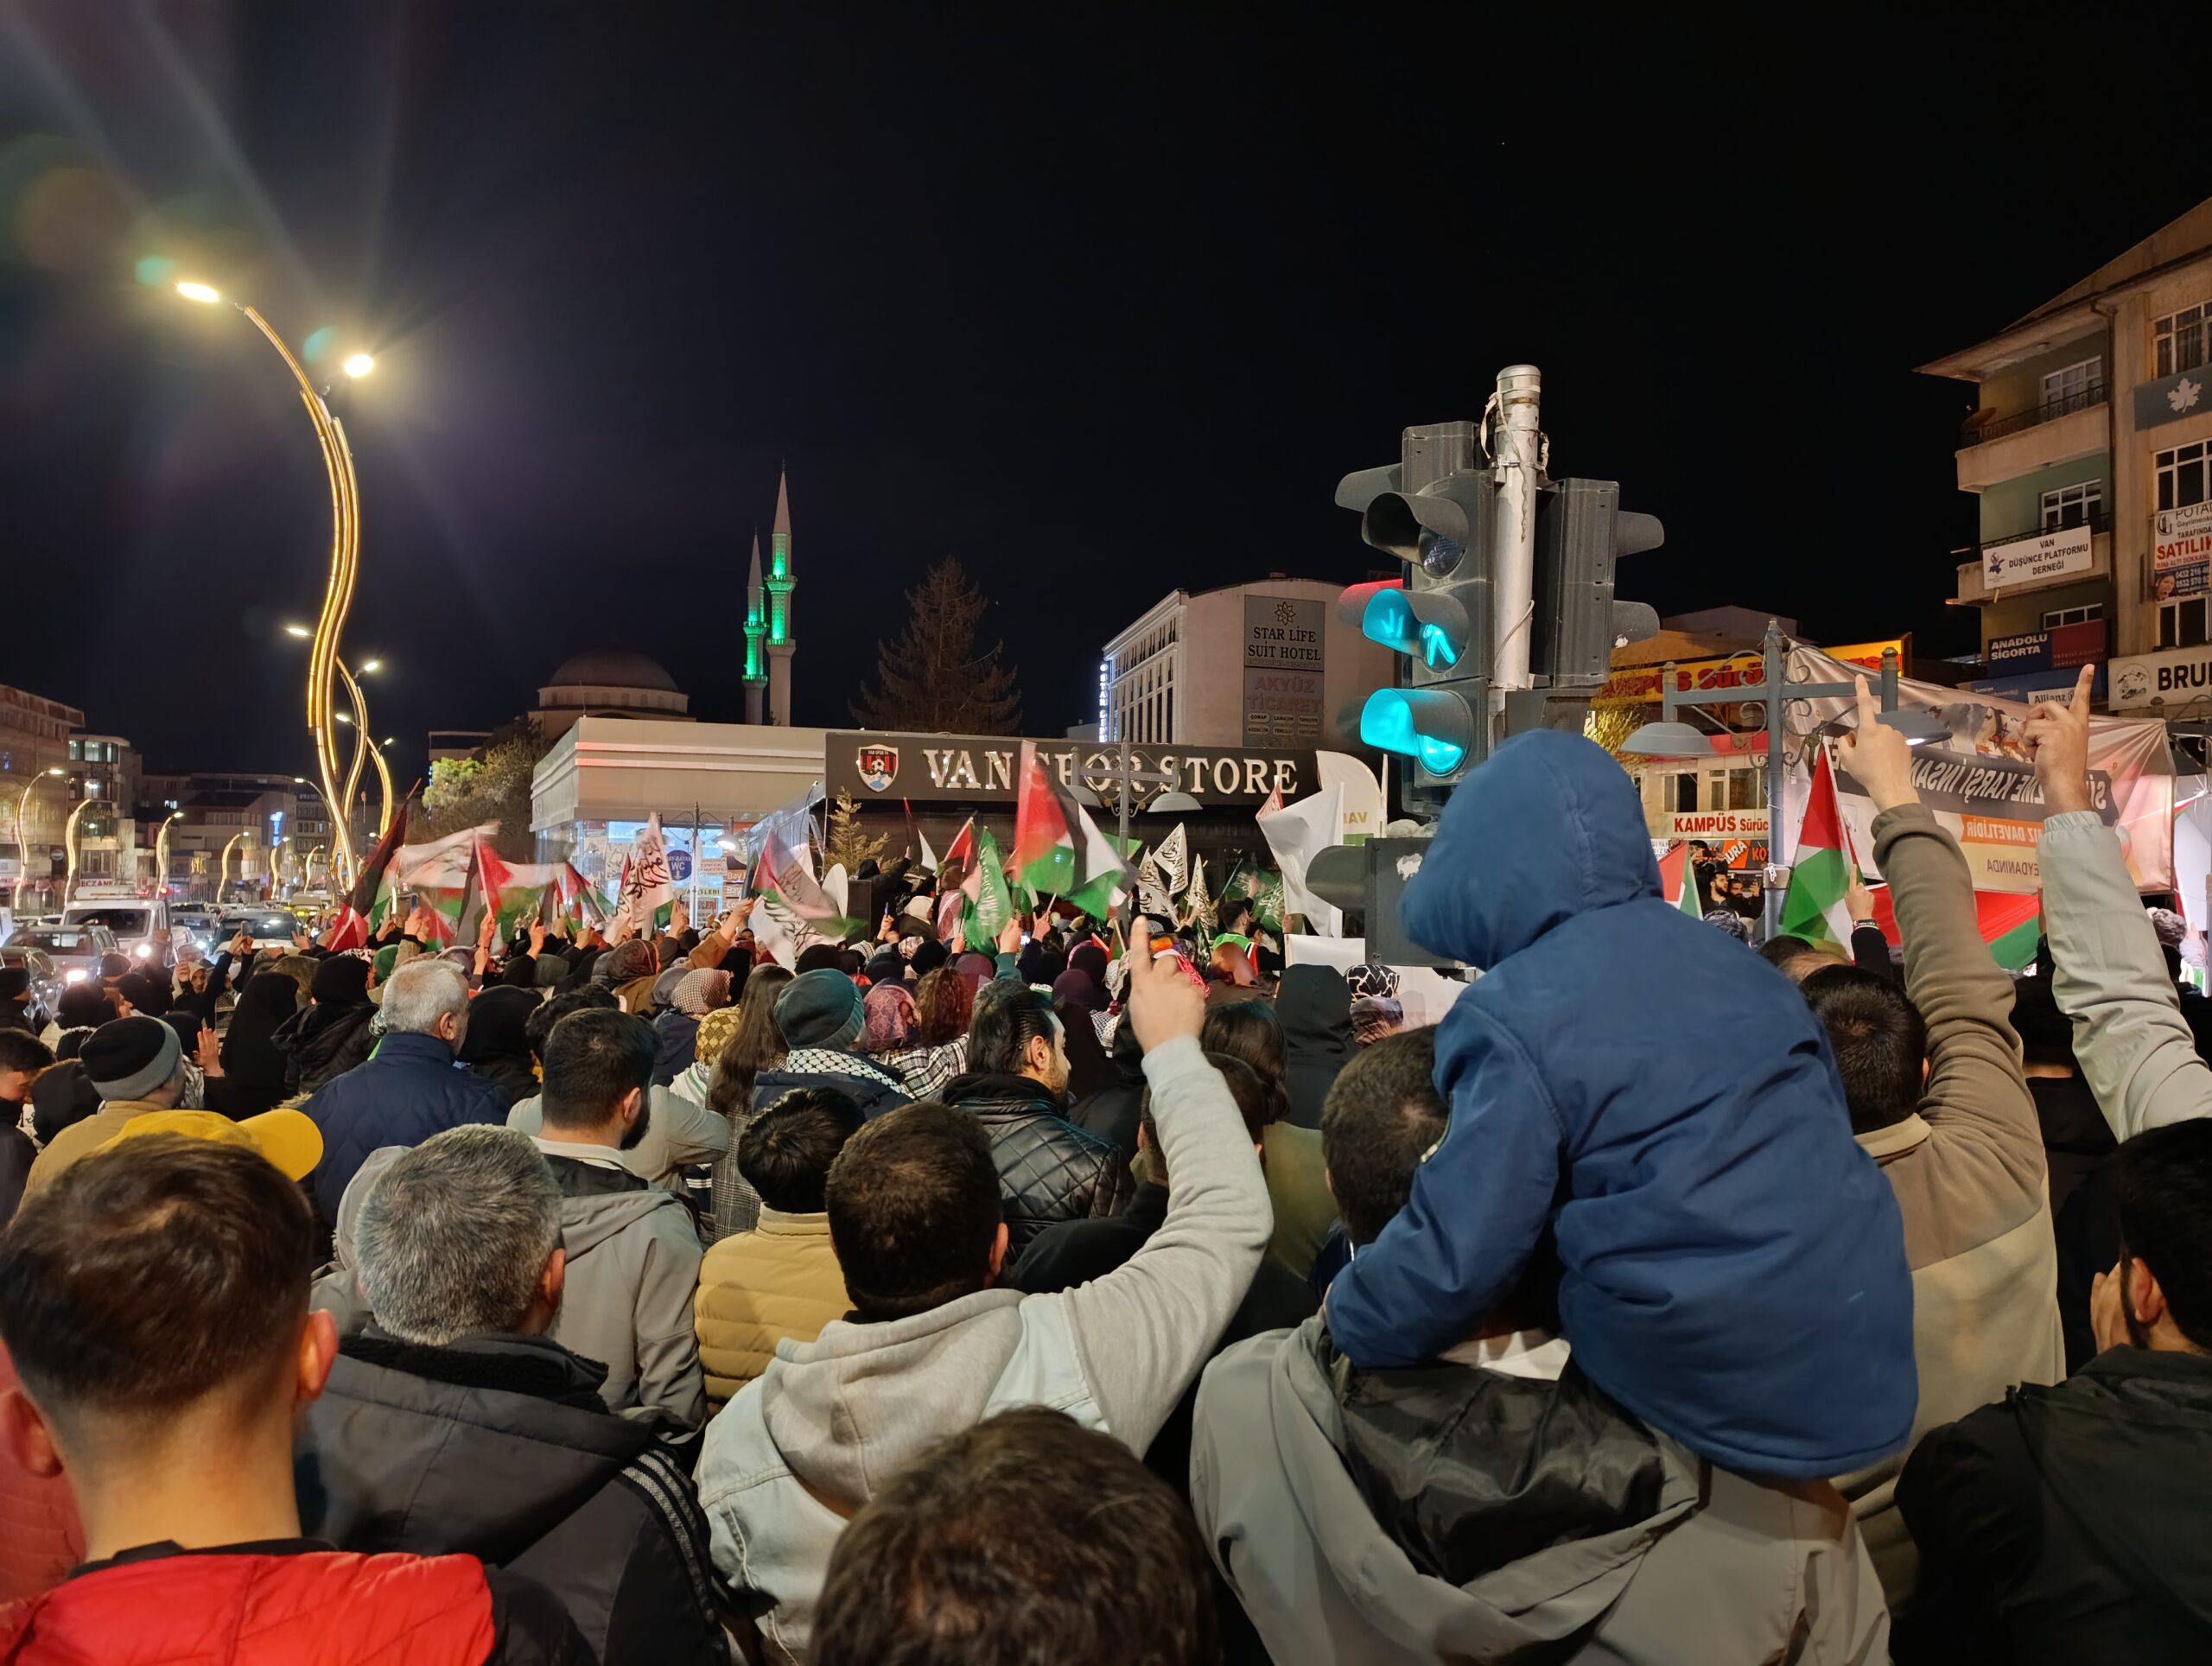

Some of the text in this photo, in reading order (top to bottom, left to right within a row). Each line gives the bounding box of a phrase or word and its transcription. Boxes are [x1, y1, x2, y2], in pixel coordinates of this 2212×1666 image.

[2177, 526, 2212, 539] TARAFINDA
[2040, 539, 2055, 549] VAN
[2009, 544, 2088, 568] DÜŞÜNCE PLATFORMU
[2032, 560, 2064, 575] DERNEĞİ
[1253, 626, 1316, 643] STAR LİFE
[1991, 633, 2048, 651] ANADOLU
[1248, 641, 1321, 661] SUİT HOTEL
[1991, 645, 2041, 660] SİGORTA
[1698, 662, 1764, 690] Sürü
[2158, 661, 2212, 691] BRU
[1255, 677, 1315, 694] AKYÜZ
[1247, 693, 1321, 713] TİCARET
[2034, 694, 2067, 704] Allianz
[922, 749, 1014, 790] VAN
[1160, 755, 1298, 795] STORE
[1675, 813, 1769, 832] KAMPÜS Sürüc
[1752, 847, 1769, 863] KO
[671, 862, 685, 871] WC
